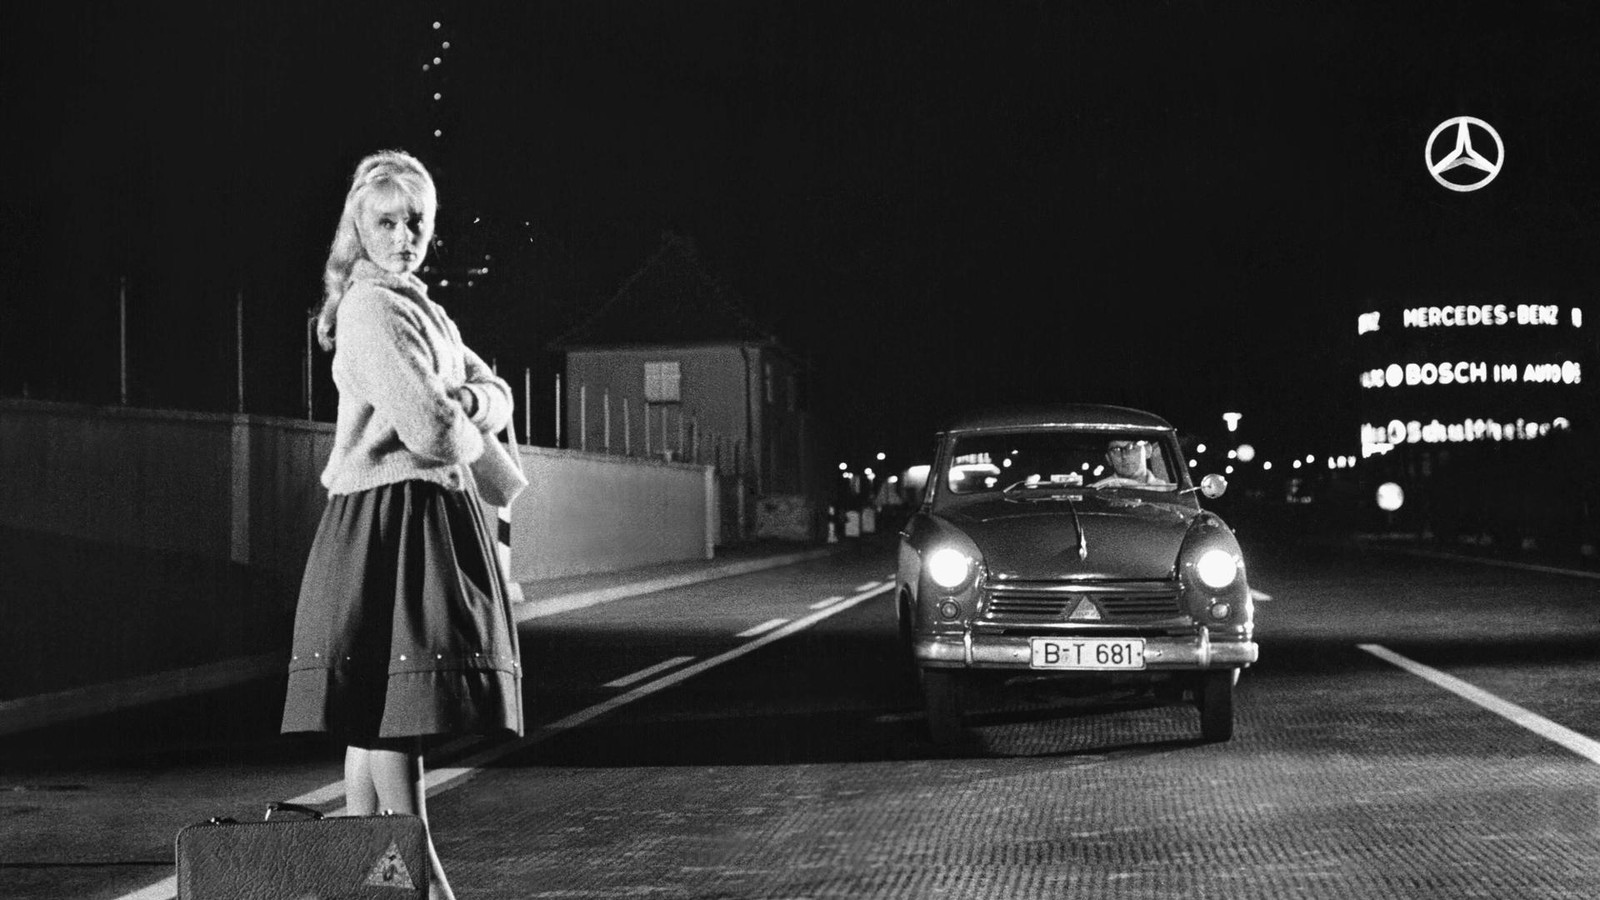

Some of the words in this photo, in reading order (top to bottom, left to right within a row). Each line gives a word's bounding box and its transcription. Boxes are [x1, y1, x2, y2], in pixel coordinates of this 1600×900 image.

[1403, 304, 1559, 328] MERCEDES-BENZ
[1405, 361, 1487, 385] BOSCH
[1493, 364, 1518, 382] IM
[1096, 643, 1132, 665] 681
